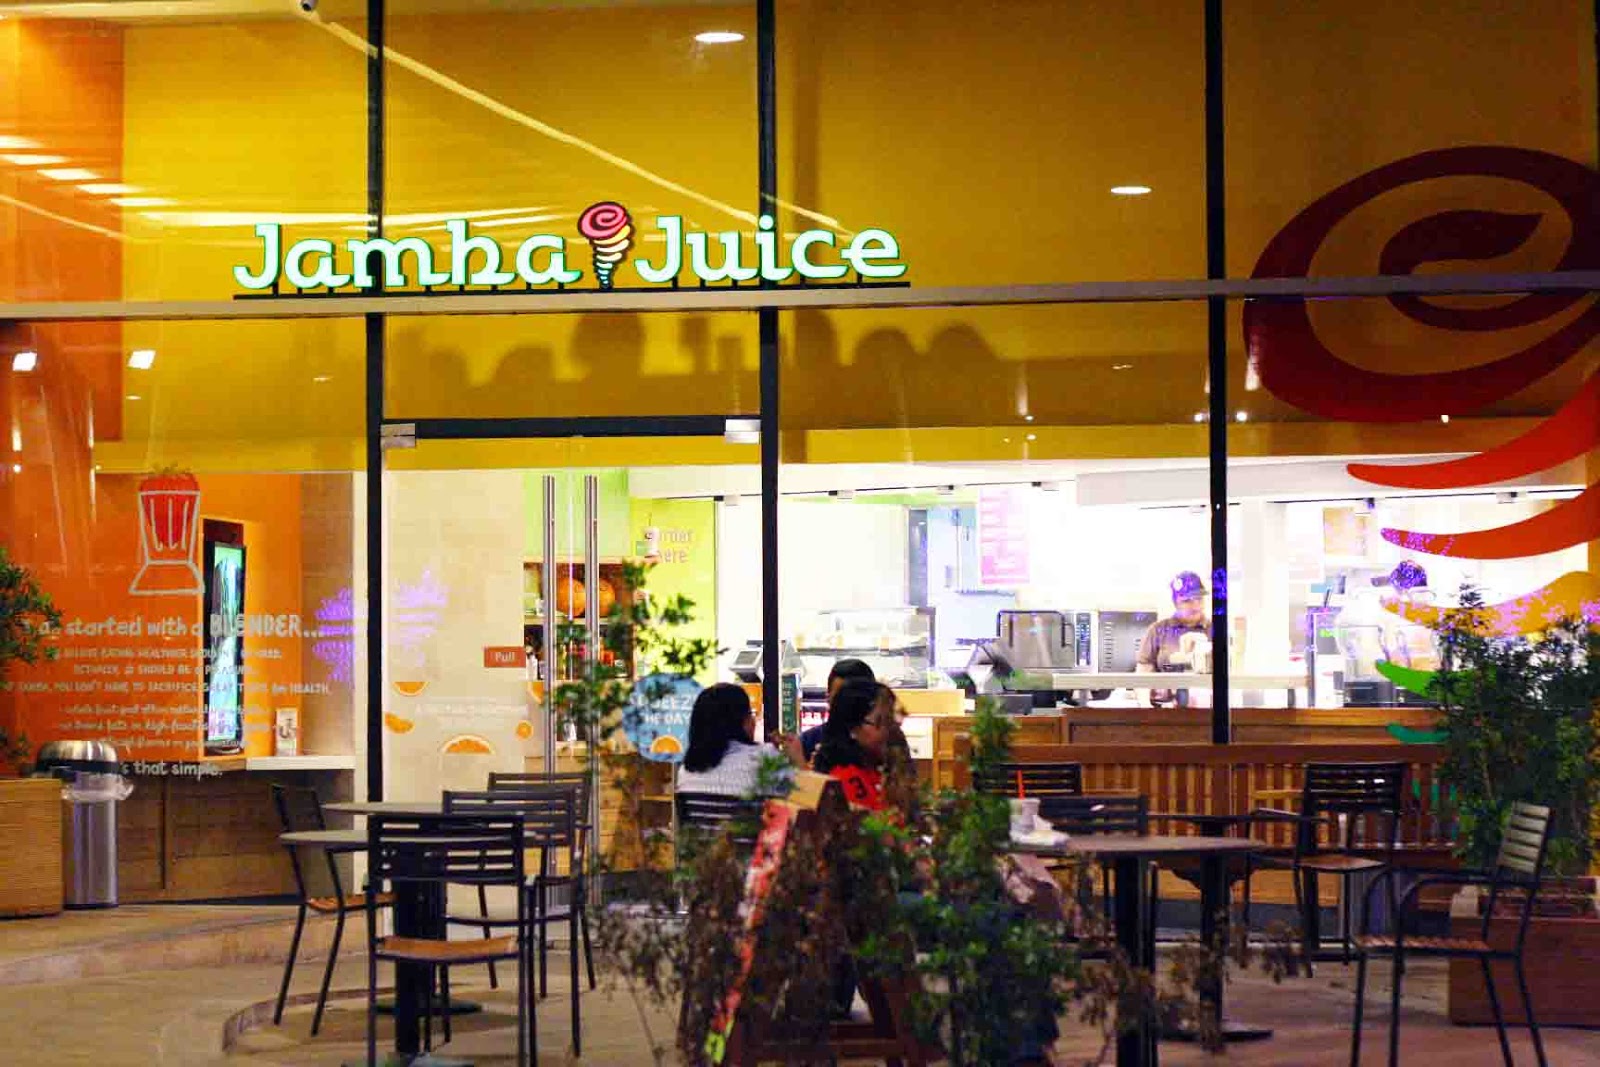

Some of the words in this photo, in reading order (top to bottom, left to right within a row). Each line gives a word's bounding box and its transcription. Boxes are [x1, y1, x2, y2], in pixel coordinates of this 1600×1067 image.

[233, 218, 583, 290] Jamba
[635, 214, 906, 283] Juice
[65, 616, 142, 636] started
[148, 615, 187, 636] with
[133, 761, 169, 776] that
[171, 760, 222, 781] simple.
